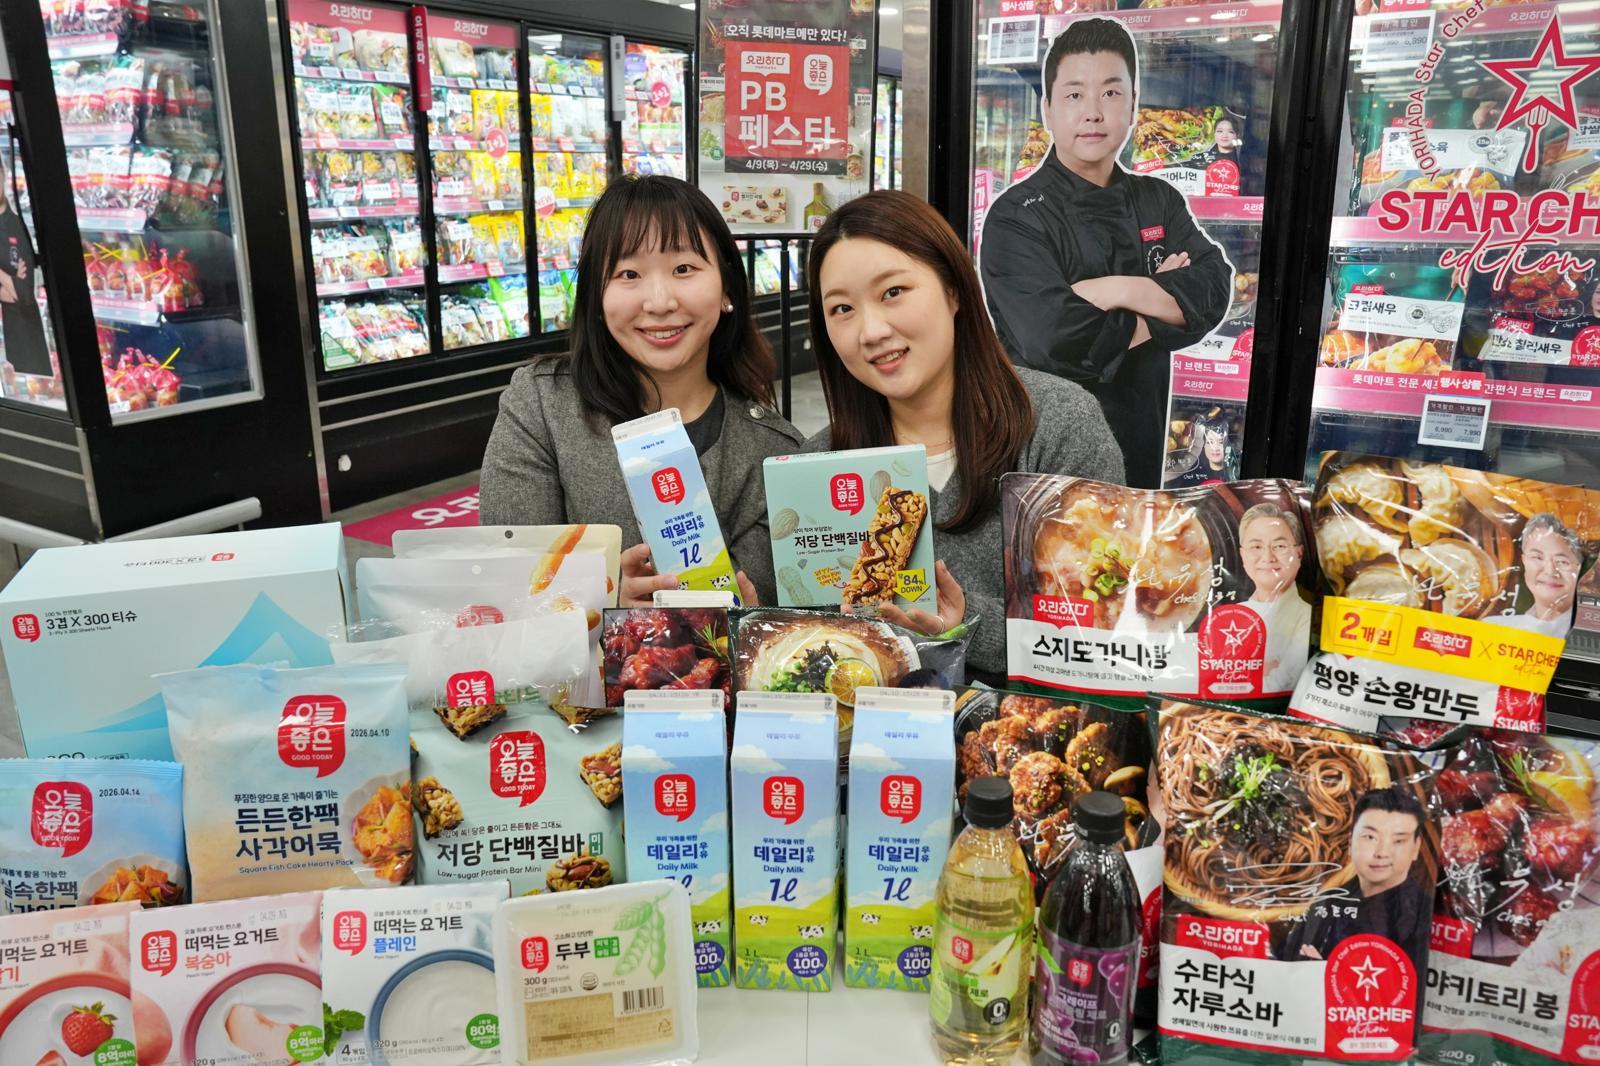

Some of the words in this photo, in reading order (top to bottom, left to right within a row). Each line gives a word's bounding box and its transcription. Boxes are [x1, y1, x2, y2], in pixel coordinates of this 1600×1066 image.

[1442, 0, 1486, 38] Chef
[728, 25, 749, 37] 오직
[752, 26, 819, 41] 롯데마트에만
[820, 29, 847, 42] 있다!
[746, 55, 786, 66] 요리하다
[1415, 42, 1445, 82] Star
[741, 80, 787, 111] PB
[738, 113, 836, 150] 페스타
[1408, 88, 1442, 182] YORIHADA
[486, 135, 506, 152] 1+1
[746, 159, 778, 170] 4/9(목)
[789, 160, 828, 171] 4/29(수)
[1378, 190, 1520, 233] STAR
[1440, 218, 1594, 291] edition
[1183, 362, 1212, 373] 브랜드
[1353, 375, 1394, 387] 롯데마트
[1398, 378, 1419, 389] 전문
[1484, 383, 1517, 396] 간편식
[1522, 387, 1556, 399] 브랜드
[660, 517, 698, 541] 데일리
[672, 537, 687, 547] Daily
[688, 533, 701, 542] Milk
[794, 535, 819, 549] 저당
[822, 530, 871, 547] 단백질바
[901, 586, 923, 594] DOWN
[1037, 602, 1089, 616] 요리하다
[46, 616, 68, 630] 3겹
[83, 614, 109, 626] 300
[112, 611, 137, 623] 티슈
[1340, 612, 1392, 647] 2개입
[1032, 634, 1171, 670] 스지도가니탕
[1420, 631, 1468, 649] 요리하다
[1497, 644, 1534, 661] STAR
[1200, 659, 1233, 671] STAR
[1234, 659, 1263, 671] CHEF
[1313, 661, 1360, 698] 평양
[1363, 676, 1480, 722] 손왕만두
[350, 729, 390, 738] 2026.04.10
[99, 788, 140, 797] 2026.04.14
[517, 784, 535, 792] TODAY
[234, 794, 257, 804] 푸짐한
[282, 793, 289, 803] 온
[291, 791, 314, 802] 가족이
[235, 803, 340, 833] 든든한팩
[510, 822, 539, 832] 든든함은
[236, 831, 342, 861] 사각어묵
[437, 840, 485, 868] 저당
[489, 832, 585, 864] 단백질바
[647, 843, 698, 860] 데일리
[699, 841, 708, 859] 우유
[754, 844, 804, 863] 데일리
[806, 846, 815, 863] 우유
[868, 844, 919, 862] 데일리
[921, 846, 930, 863] 우유
[239, 865, 267, 874] Square
[307, 860, 335, 869] Hearty
[437, 868, 480, 880] Low-sugar
[481, 866, 508, 877] Protein
[509, 865, 523, 874] Bar
[524, 864, 542, 873] Mini
[658, 863, 679, 871] Daily
[680, 862, 698, 870] Milk
[763, 865, 784, 874] Daily
[787, 865, 804, 873] Milk
[878, 864, 899, 873] Daily
[900, 865, 919, 873] Milk
[374, 918, 417, 934] 떠먹는
[420, 916, 463, 931] 요거트
[1185, 922, 1262, 944] 요리하다
[40, 939, 88, 958] 요거트
[185, 934, 231, 952] 떠먹는
[234, 928, 279, 946] 요거트
[374, 936, 417, 954] 플레인
[1202, 940, 1243, 952] YORIHADA
[555, 941, 591, 961] 두부
[185, 952, 232, 971] 복숭아
[524, 977, 540, 986] 300
[542, 977, 548, 985] g
[1174, 959, 1255, 994] 수타식
[1426, 968, 1527, 1014] 야키토리
[1533, 991, 1559, 1020] 봉
[1172, 986, 1283, 1028] 자루소바
[1327, 1006, 1367, 1022] STAR
[1368, 1006, 1413, 1023] CHEF
[1206, 1022, 1227, 1033] 시원한
[1347, 1020, 1389, 1040] edition
[341, 1044, 350, 1056] 4
[373, 1040, 390, 1048] 320
